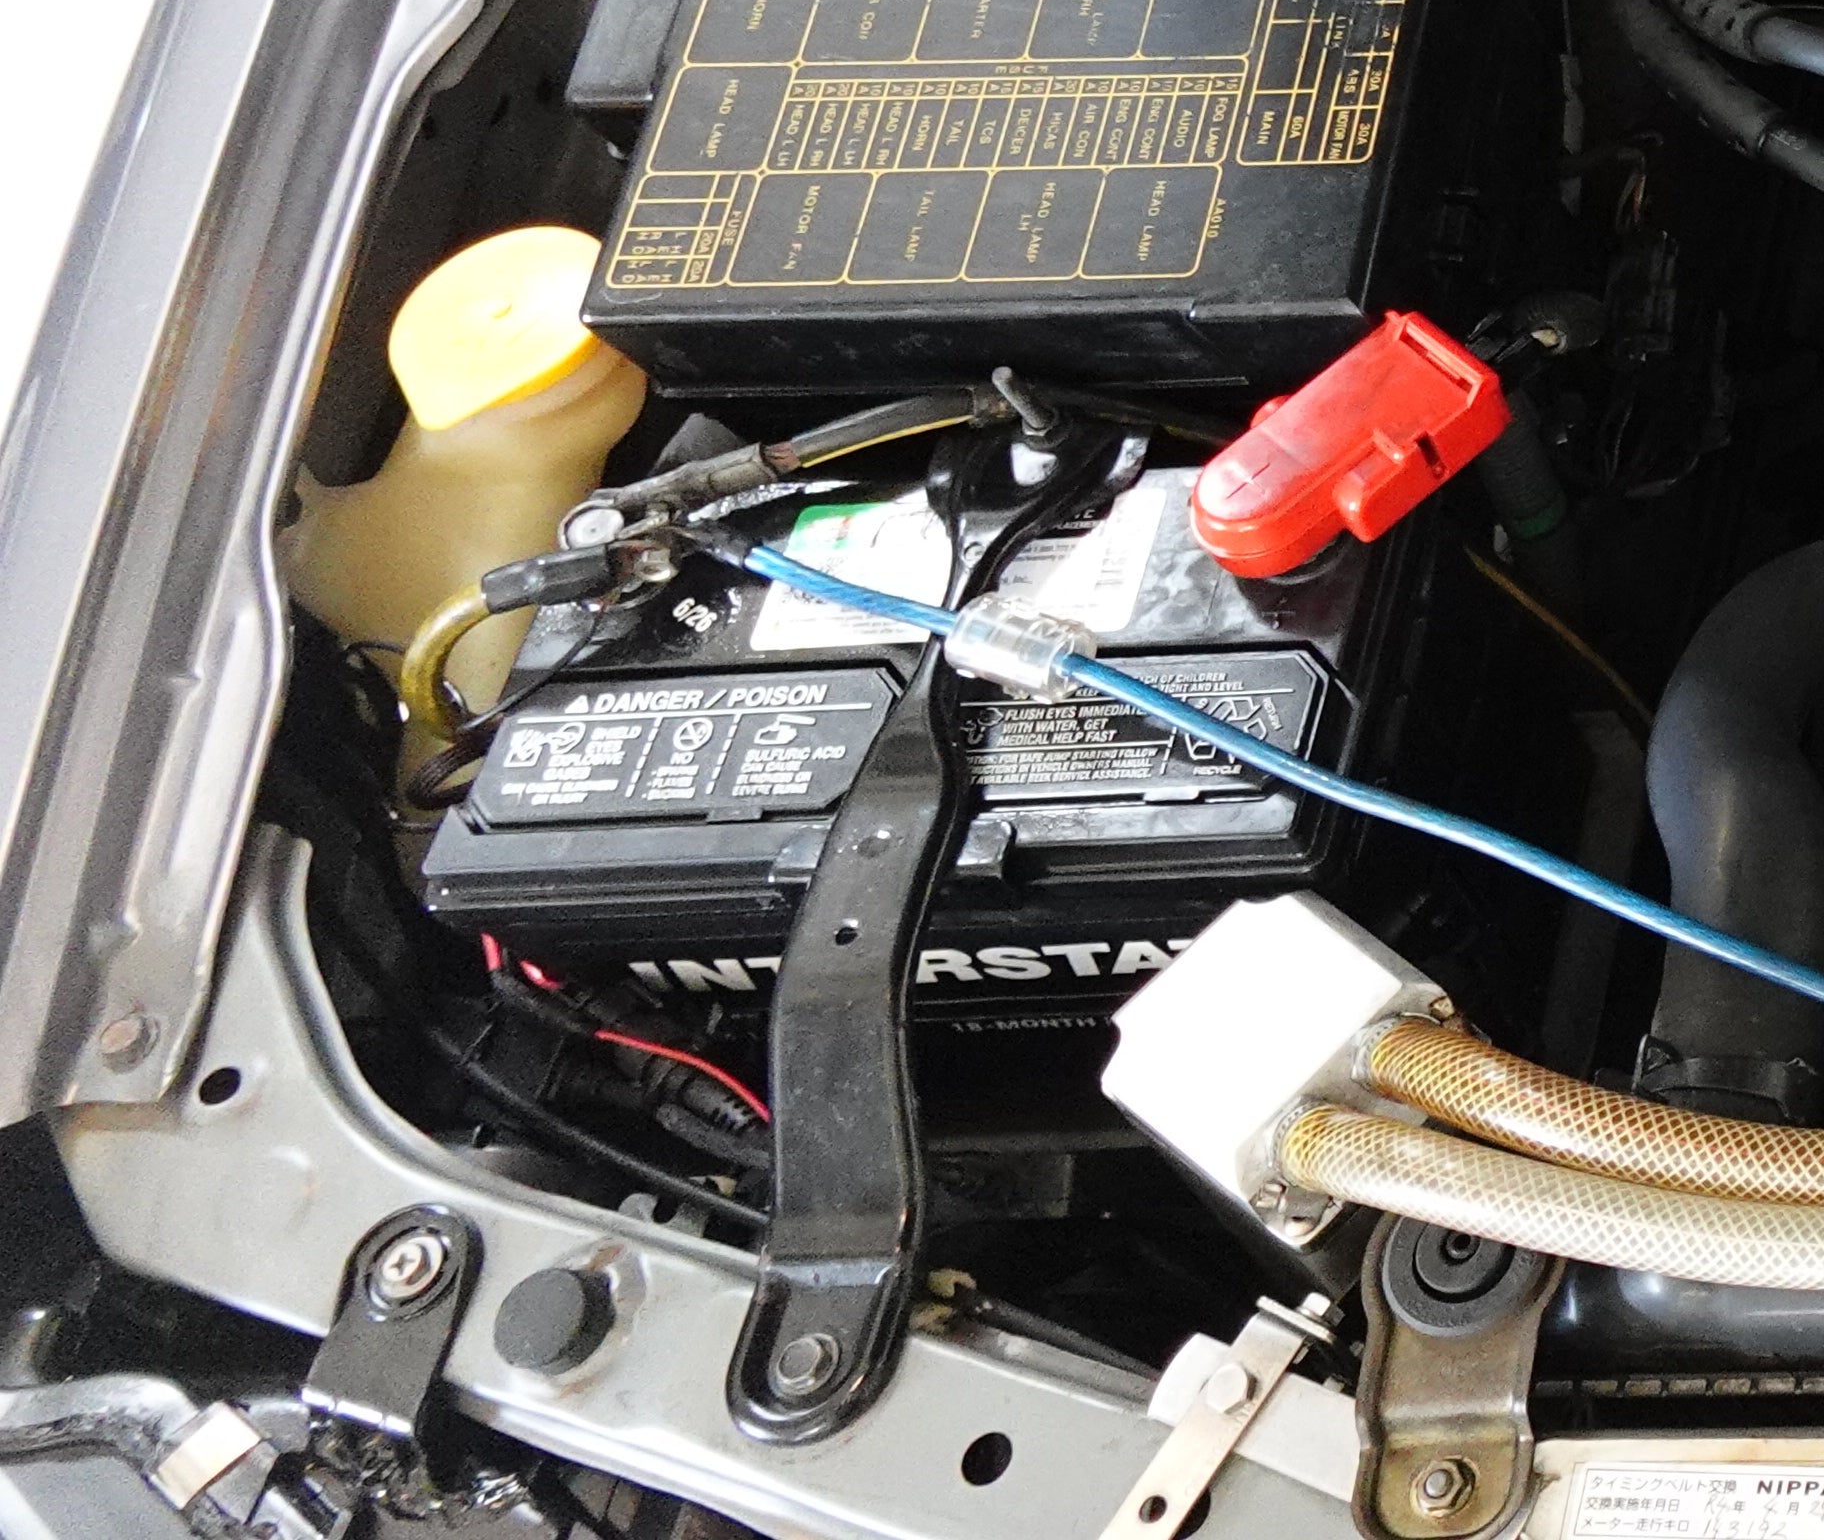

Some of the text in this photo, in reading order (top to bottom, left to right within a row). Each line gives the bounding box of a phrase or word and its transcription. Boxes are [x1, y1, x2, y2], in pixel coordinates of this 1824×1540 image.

[859, 11, 875, 40] CON
[1344, 69, 1359, 94] ABS
[705, 79, 740, 158] HEAD LAMP
[785, 104, 806, 135] HEAD
[820, 103, 839, 133] HEAD
[852, 103, 871, 134] HEAD
[886, 102, 905, 132] HEAD
[1010, 109, 1031, 154] DEICER
[1043, 112, 1063, 149] HICAS
[1073, 103, 1099, 157] AIR CON
[1105, 99, 1131, 160] ENG CONT
[1139, 98, 1164, 159] ENG CONT
[1174, 109, 1193, 147] AUDIO
[1205, 98, 1228, 157] FOG LAMP
[1257, 111, 1275, 145] MAIN
[1335, 110, 1350, 142] MOTOR
[912, 115, 932, 151] HORN
[946, 120, 964, 146] TAIL
[979, 120, 996, 144] TCS
[1357, 123, 1371, 145] 30A
[795, 185, 821, 234] MOTOR
[1018, 214, 1032, 231] LH
[1026, 182, 1056, 263] HEAD LAMP
[1136, 180, 1168, 261] HEAD LAMP
[722, 211, 742, 245] FUSE
[904, 190, 937, 262] TAIL LAMP
[672, 597, 718, 633] 6/26
[1160, 673, 1227, 683] OF CHILDREN
[1160, 681, 1244, 692] TIGHT AND LEVEL
[594, 691, 704, 713] DANGER
[727, 684, 828, 706] POISON
[1002, 718, 1108, 735] WITH WATER, GET
[1004, 707, 1076, 721] FLUSH EYES
[998, 730, 1117, 747] MEDICAL HELP FAST
[670, 752, 695, 764] NO
[745, 745, 846, 762] SULFURIC ACID
[1030, 762, 1068, 773] VEHICLE
[1071, 750, 1116, 761] STARTING
[1117, 748, 1158, 759] FOLLOW
[1052, 771, 1092, 782] SERVICE
[1193, 765, 1242, 776] RECYCLE
[1589, 1475, 1737, 1493] タイミングベルト交換
[1585, 1496, 1680, 1512] 交換実施年月日
[1733, 1500, 1746, 1513] 年
[1787, 1501, 1799, 1515] 月
[1581, 1516, 1690, 1534] メーター走行キロ
